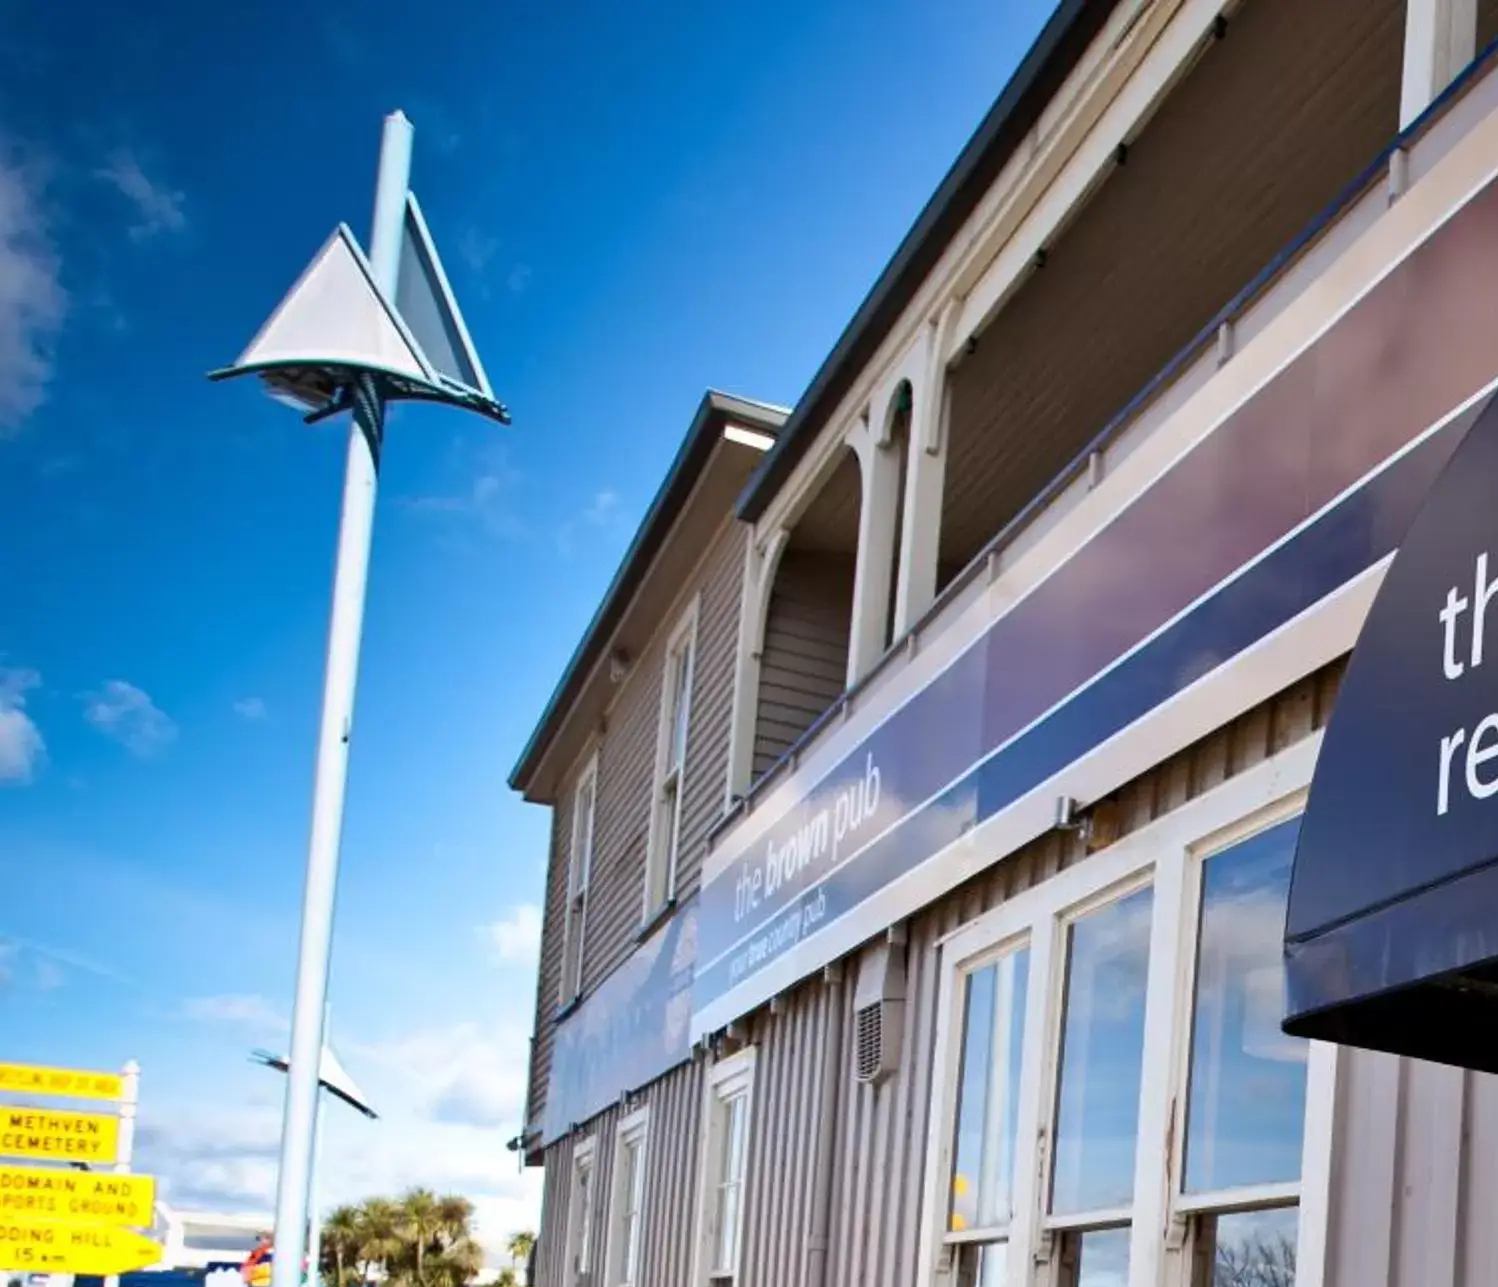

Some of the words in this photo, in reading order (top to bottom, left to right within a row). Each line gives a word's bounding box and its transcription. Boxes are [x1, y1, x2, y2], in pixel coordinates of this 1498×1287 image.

[734, 863, 762, 922] the
[764, 809, 829, 897] brown
[830, 752, 882, 862] pub
[9, 1113, 100, 1134] METHVEN
[2, 1132, 102, 1153] CEMETERY
[0, 1173, 77, 1193] DOMAIN
[93, 1181, 132, 1197] AND
[0, 1193, 56, 1211] PORTS
[69, 1198, 138, 1217] GROUND
[71, 1231, 112, 1248] HILL
[14, 1247, 34, 1263] 15
